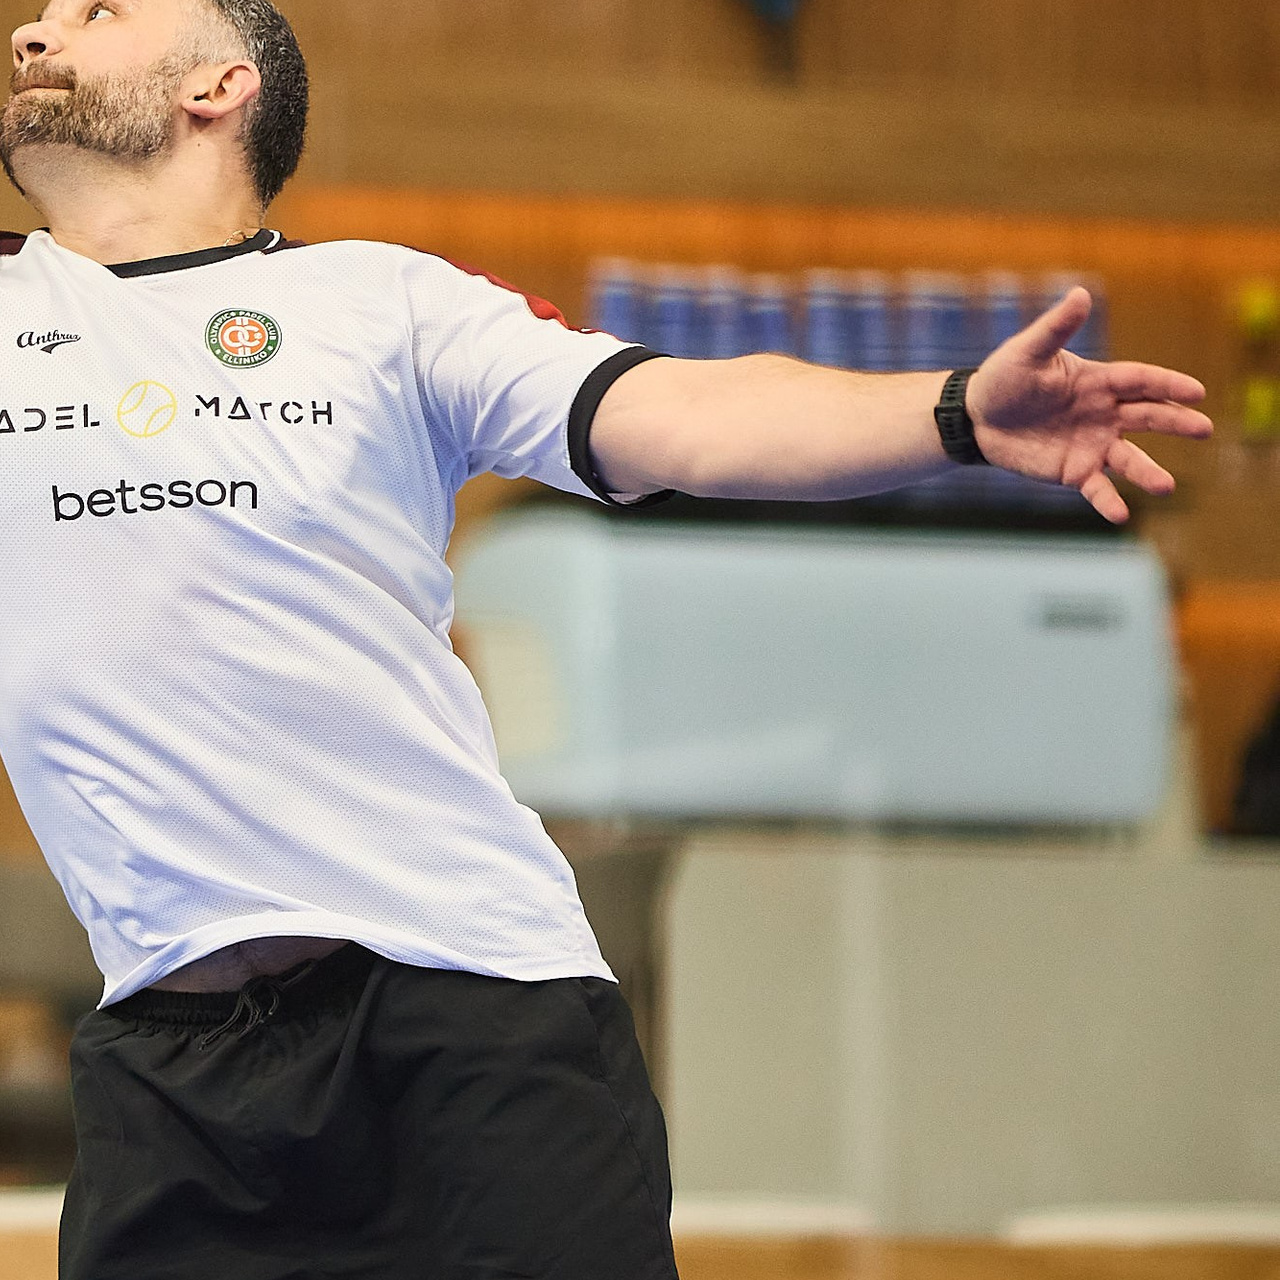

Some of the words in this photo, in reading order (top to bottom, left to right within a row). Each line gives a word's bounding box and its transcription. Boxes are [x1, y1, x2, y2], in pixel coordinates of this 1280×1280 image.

[210, 311, 232, 344] OLYMPIC
[238, 310, 267, 323] PADEL
[265, 322, 277, 341] CLUB
[222, 351, 268, 365] ELLINIKO
[194, 394, 333, 425] MATCH
[51, 478, 258, 522] betsson
